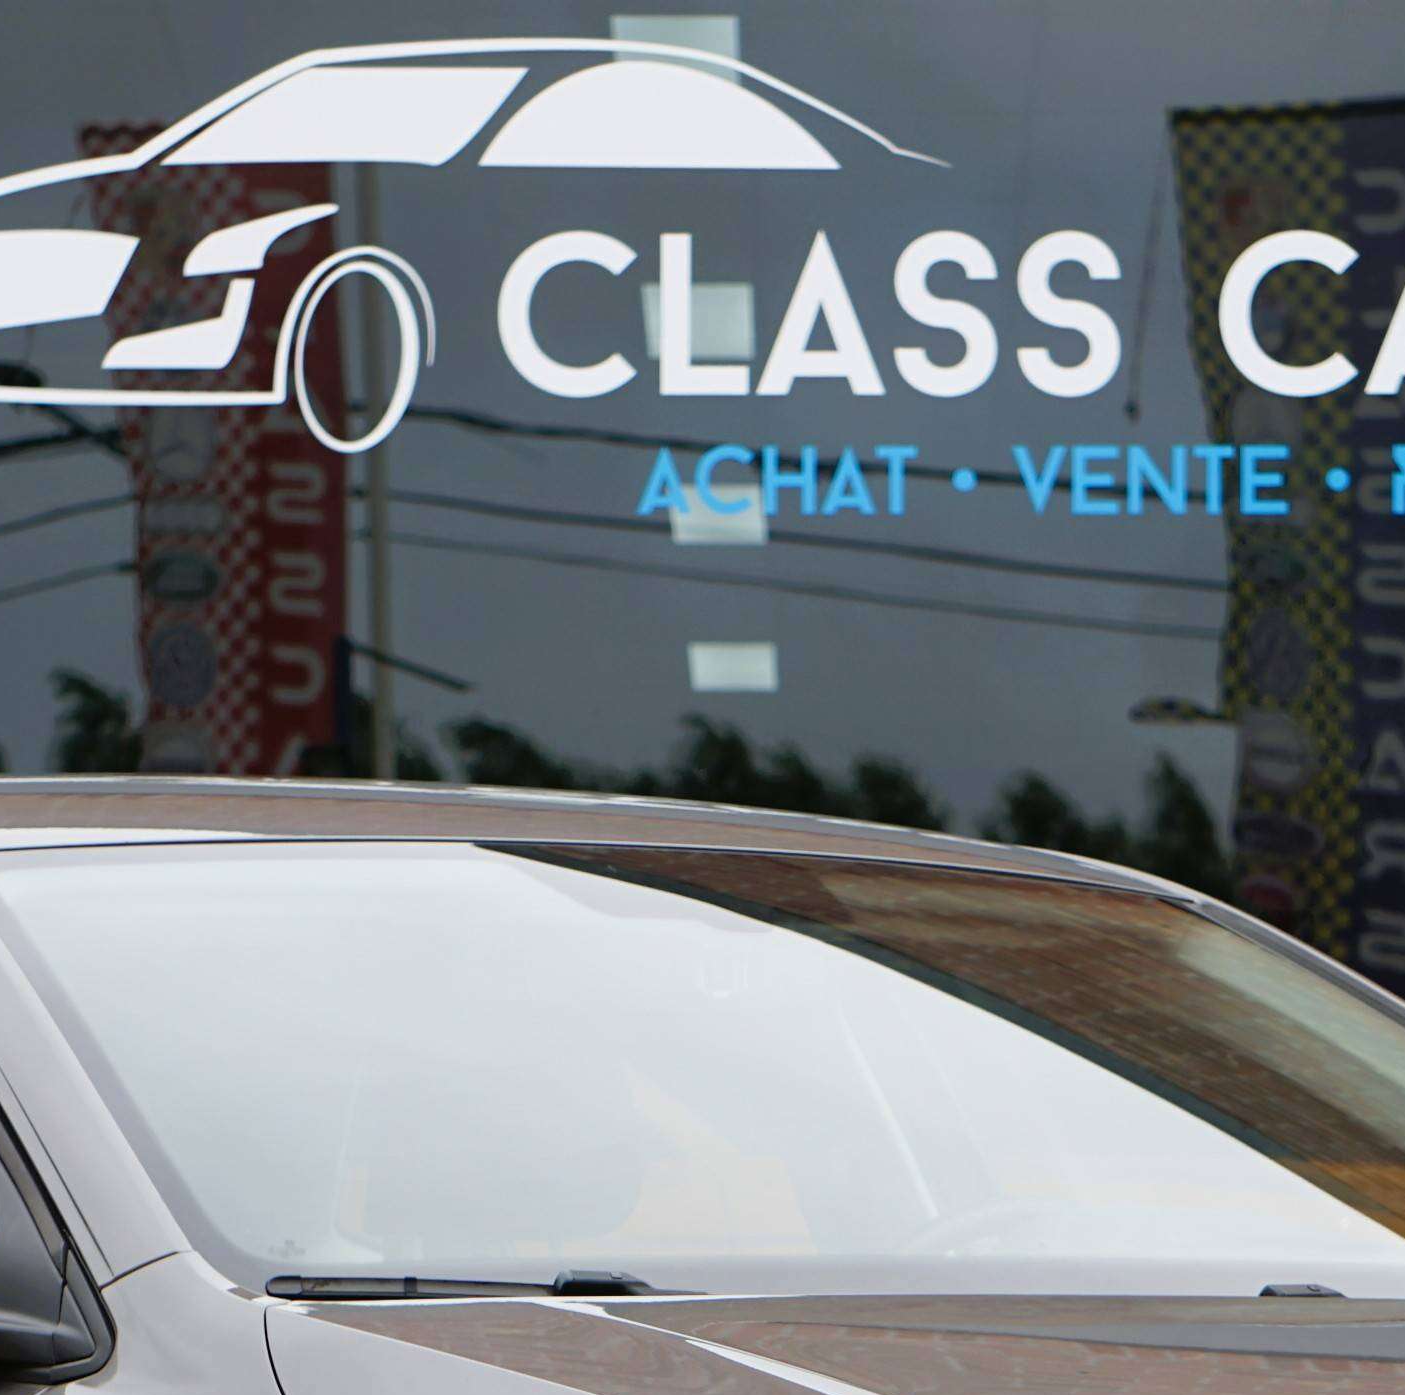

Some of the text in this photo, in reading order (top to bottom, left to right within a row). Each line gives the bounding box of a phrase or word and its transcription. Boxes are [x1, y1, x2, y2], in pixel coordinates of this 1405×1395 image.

[498, 229, 1121, 397] CLASS
[635, 442, 921, 518] ACHAT
[1011, 442, 1293, 518] VENTE
